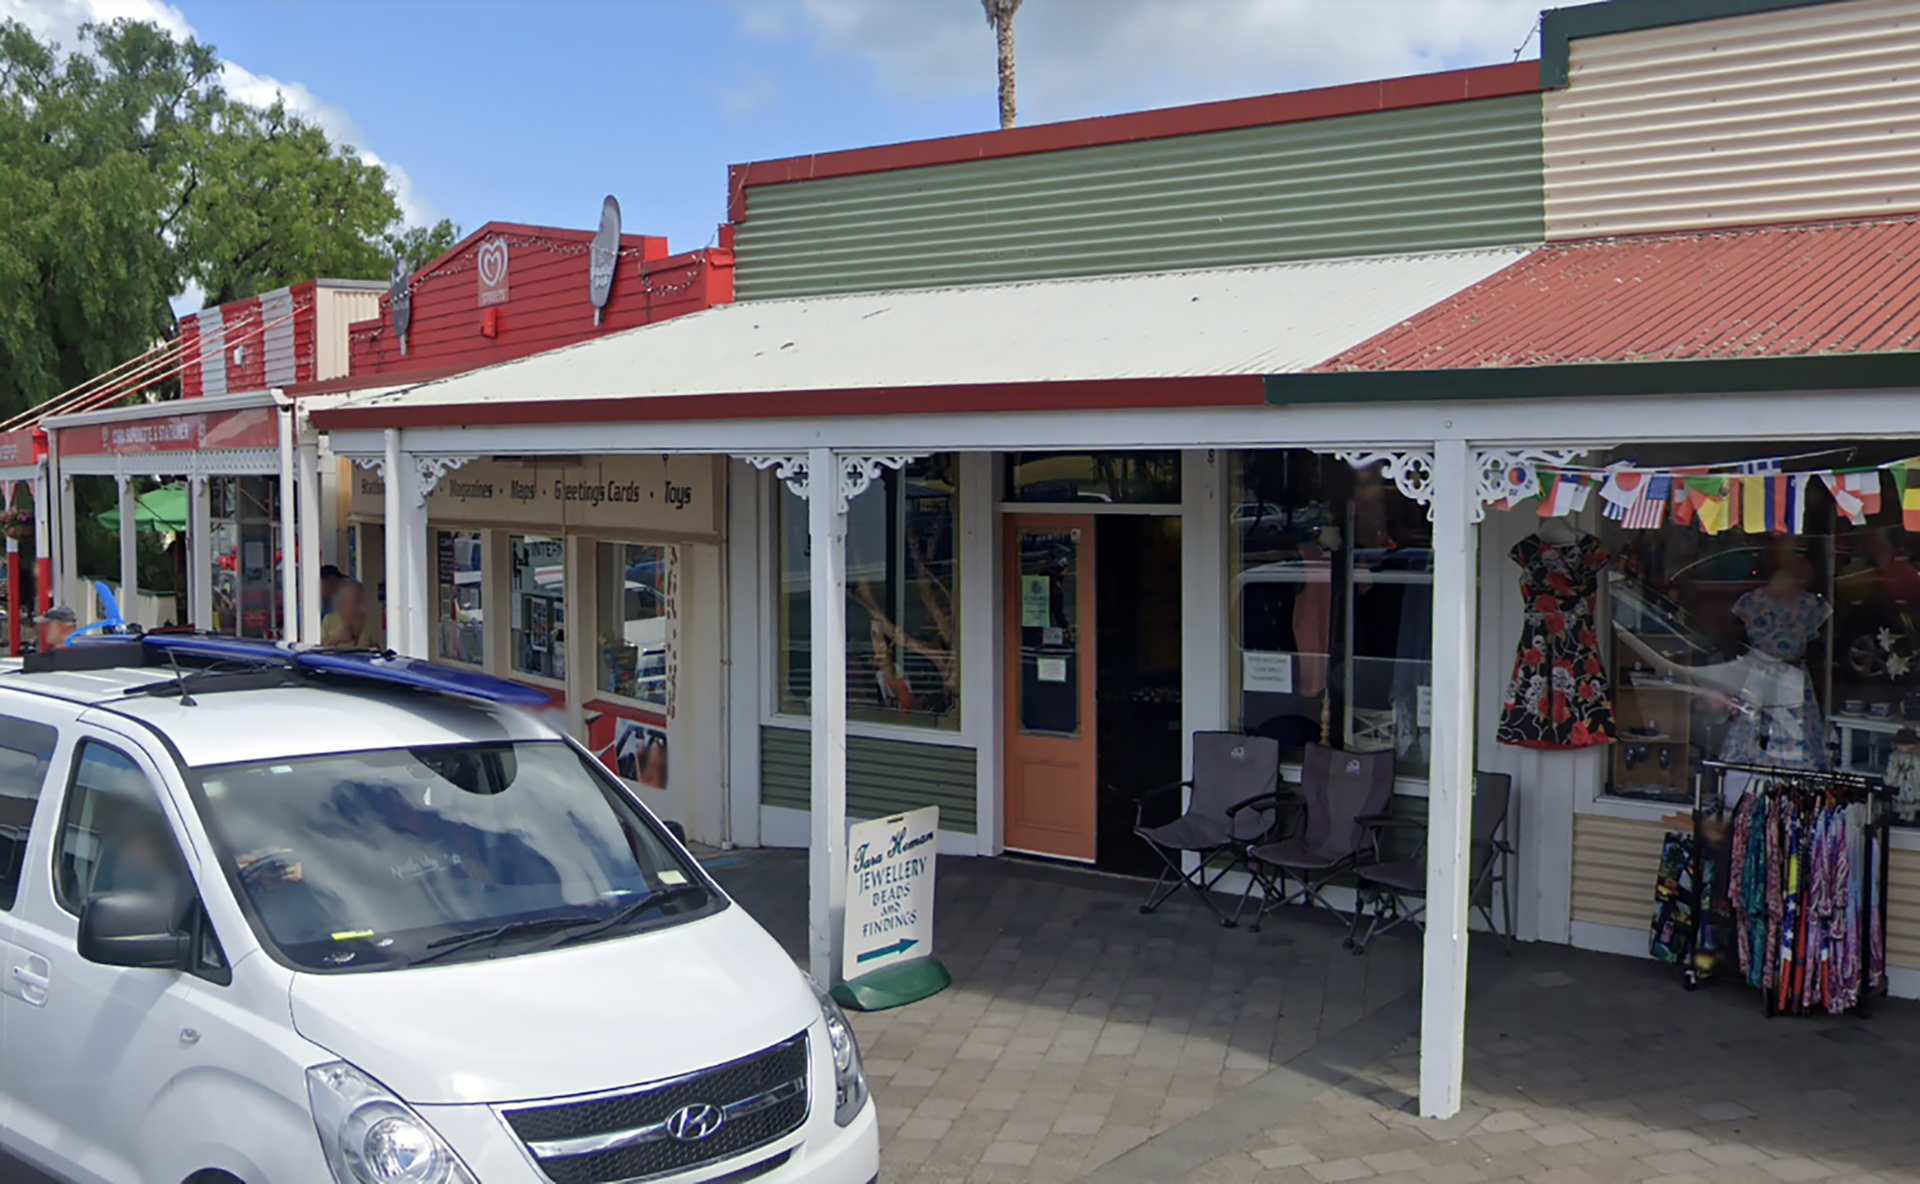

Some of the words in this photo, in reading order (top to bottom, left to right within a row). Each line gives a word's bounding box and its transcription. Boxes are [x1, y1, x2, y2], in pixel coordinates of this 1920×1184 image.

[450, 479, 493, 502] Magazines
[511, 480, 535, 504] Maps
[554, 480, 605, 506] Greetings
[607, 481, 640, 502] Cards
[664, 481, 692, 509] Toys
[853, 842, 883, 873] Tara
[859, 856, 927, 895] JEWELLERY
[872, 882, 911, 906] BEADS
[862, 909, 918, 937] FINDINGS
